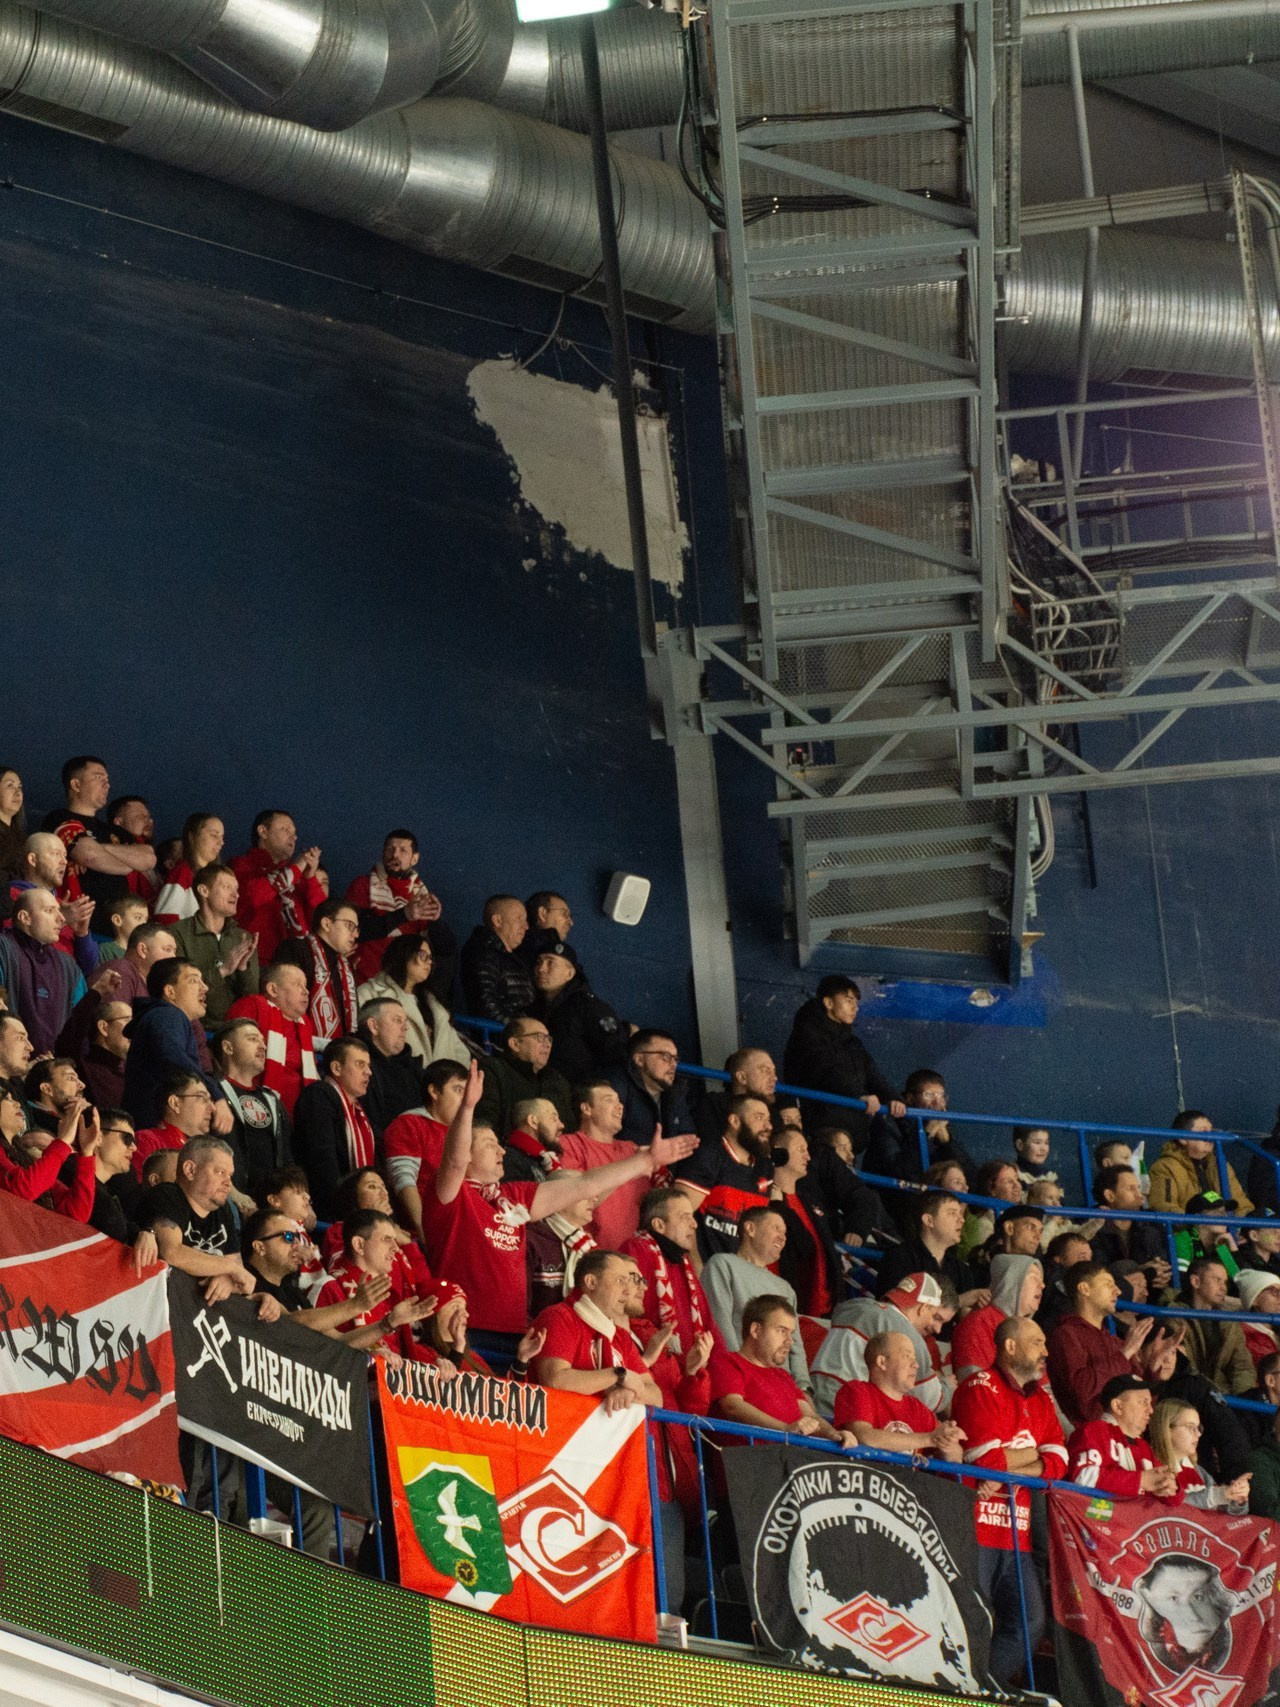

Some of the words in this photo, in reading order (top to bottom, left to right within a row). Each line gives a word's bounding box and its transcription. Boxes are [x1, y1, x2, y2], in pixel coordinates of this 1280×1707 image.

[763, 1470, 832, 1553] ОХОТИКИ
[838, 1469, 864, 1494] ЗА
[855, 1519, 868, 1534] N
[1133, 1527, 1211, 1558] РОШАЛЬ
